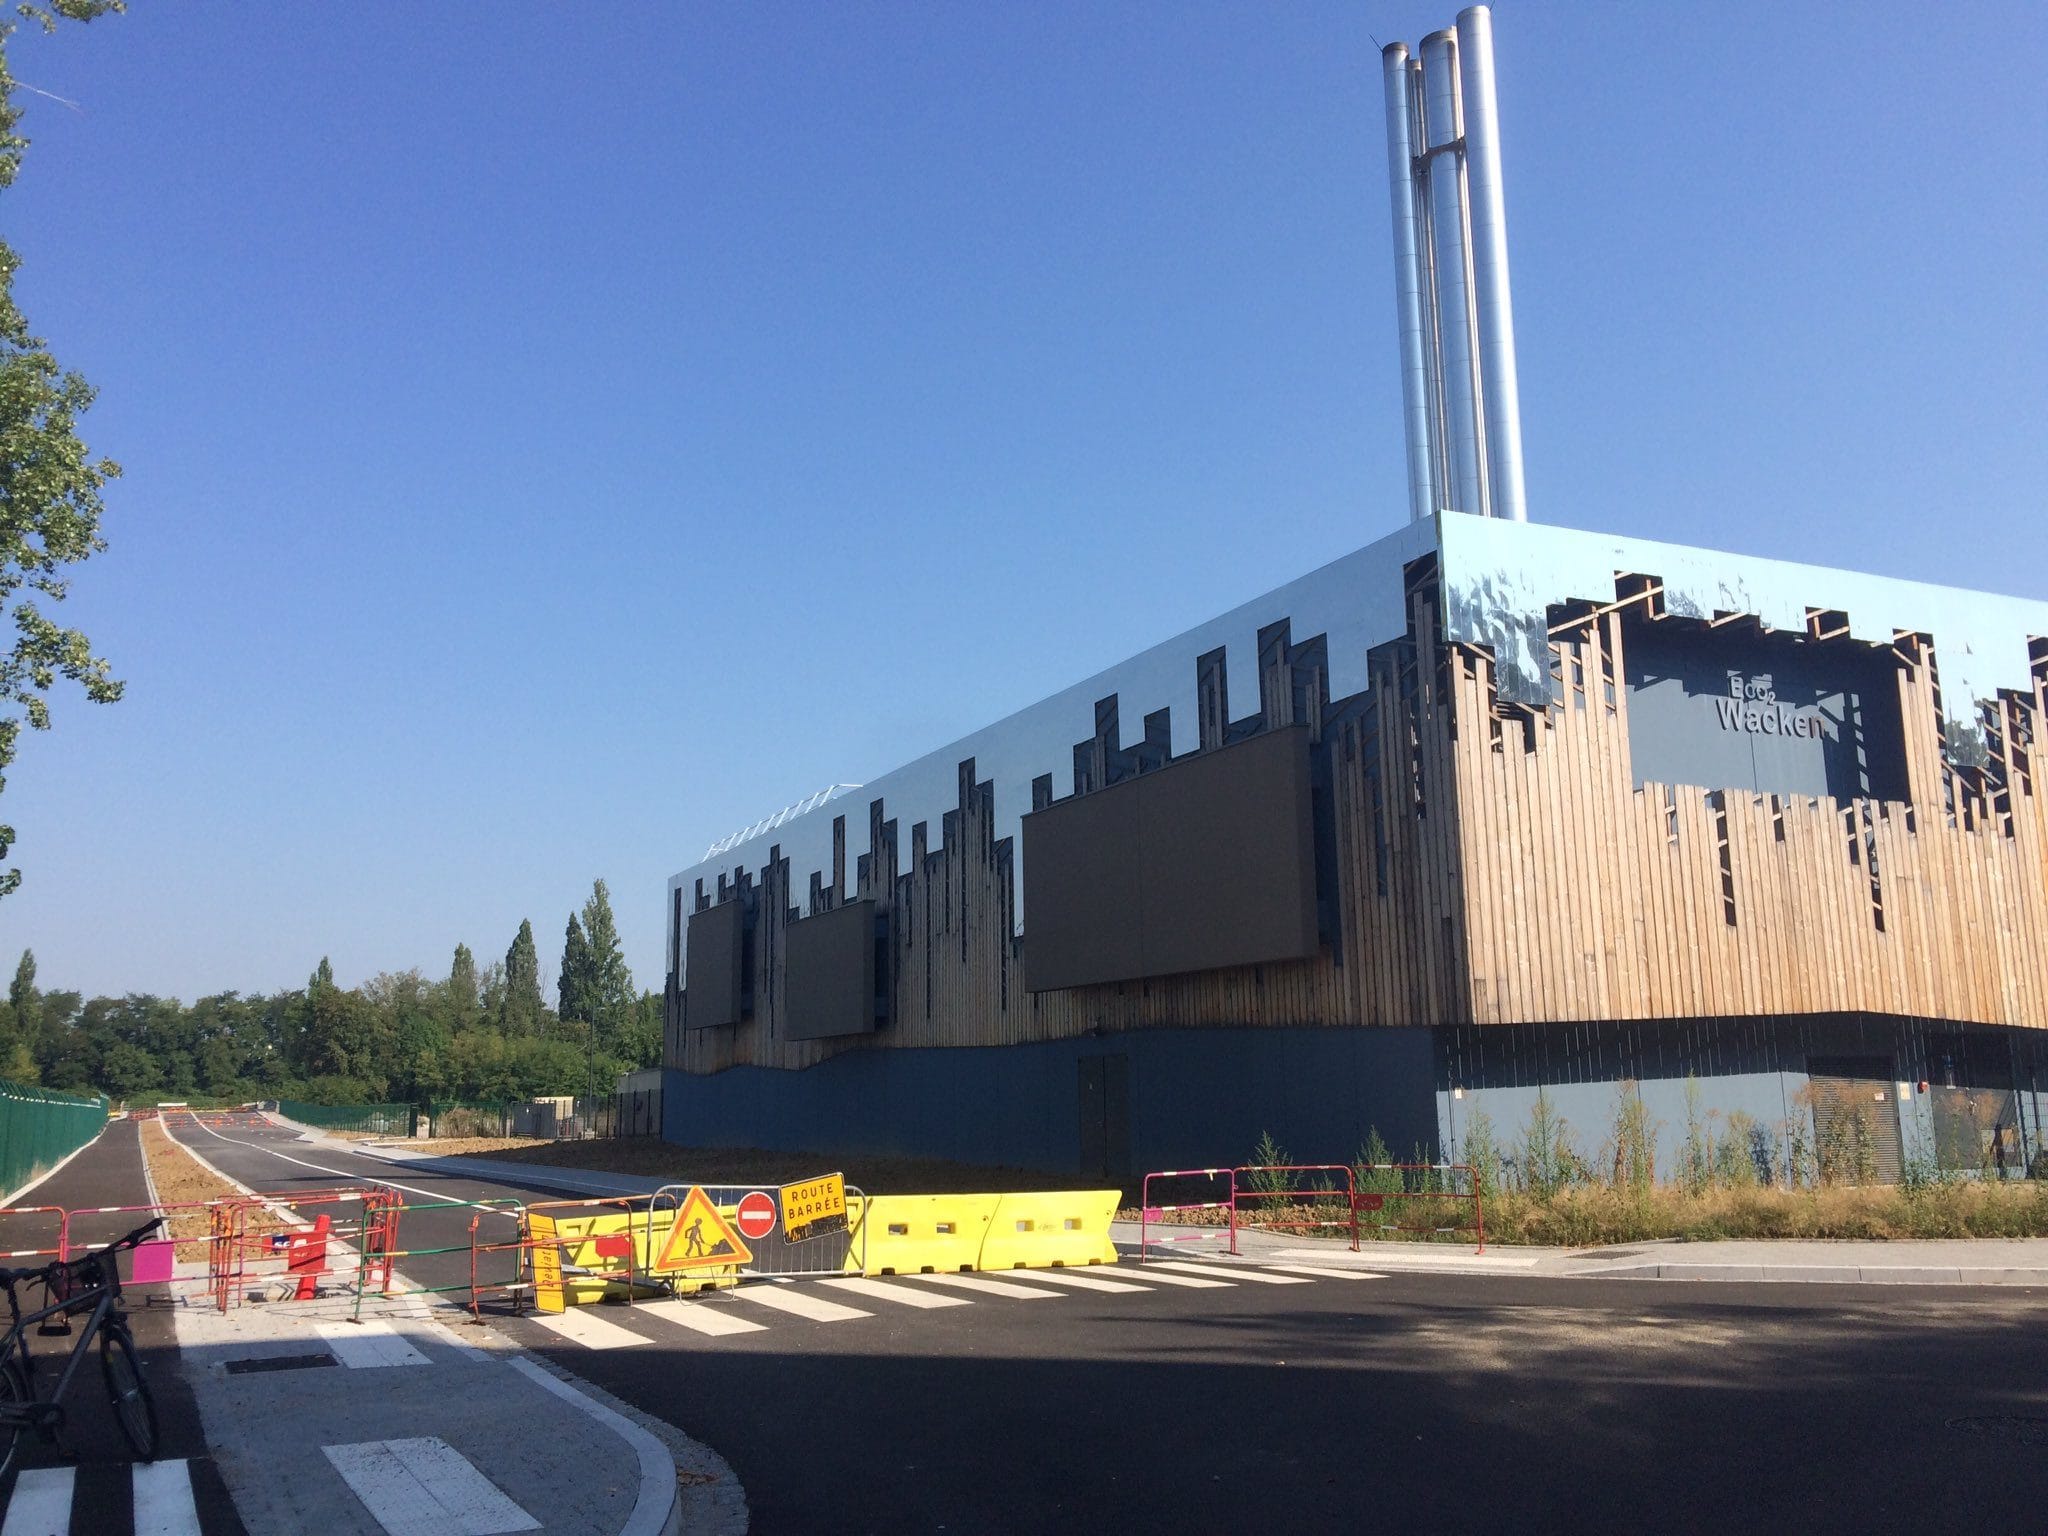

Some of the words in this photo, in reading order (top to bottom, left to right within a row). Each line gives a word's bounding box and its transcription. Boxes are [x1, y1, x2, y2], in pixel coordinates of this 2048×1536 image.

[1716, 697, 1825, 740] Wacken
[791, 1182, 834, 1202] ROUTE
[788, 1197, 840, 1219] BARRÉE
